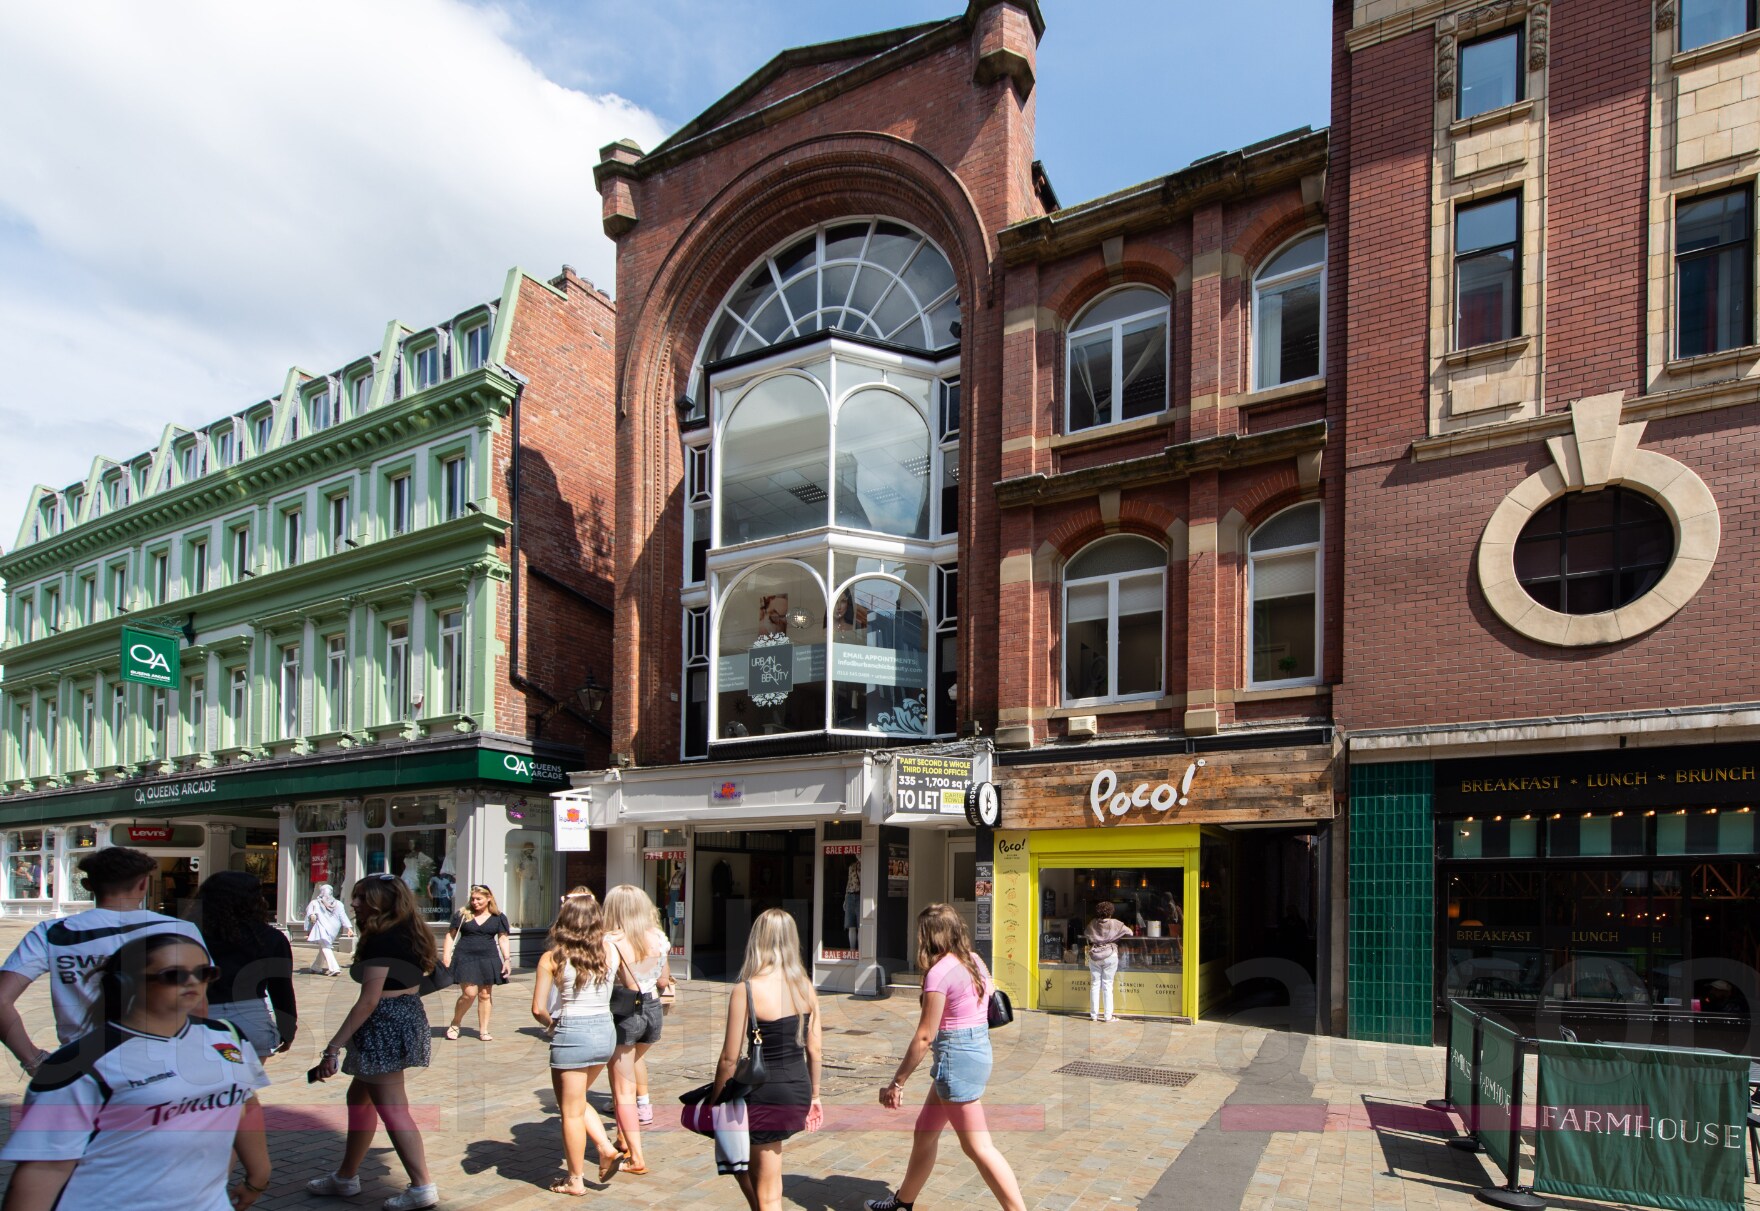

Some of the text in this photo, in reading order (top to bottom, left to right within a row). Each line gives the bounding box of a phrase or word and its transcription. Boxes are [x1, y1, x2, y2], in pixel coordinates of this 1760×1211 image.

[751, 656, 776, 668] URBAN
[843, 652, 863, 660] EMAIL
[763, 663, 782, 674] CHIC
[761, 671, 789, 685] BEAUTY
[529, 762, 562, 772] QUEENS
[900, 757, 916, 765] PART
[917, 758, 942, 767] SECOND
[949, 761, 971, 769] WHOLE
[531, 770, 563, 780] ARCADE
[903, 765, 968, 776] THIRD FLOOR OFFICES
[898, 775, 916, 785] 335
[925, 777, 950, 788] 1,700
[951, 780, 962, 789] sq
[1461, 766, 1756, 793] BREAKFAST LUNCH BRUNCH
[147, 784, 180, 799] QUEENS
[181, 780, 216, 795] ARCADE
[1090, 763, 1196, 823] Poco!
[898, 789, 940, 810] TO LET
[825, 845, 860, 855] SALE SALE
[999, 838, 1026, 854] Poco!
[645, 851, 687, 860] SALE SALE
[190, 856, 199, 872] 5
[1456, 930, 1532, 942] BREAKFAST
[1571, 931, 1618, 943] LUNCH
[669, 947, 684, 955] ALE
[824, 951, 859, 960] SALE SALE
[128, 1070, 177, 1088] hummel
[1542, 1105, 1741, 1149] FARMHOUSE
